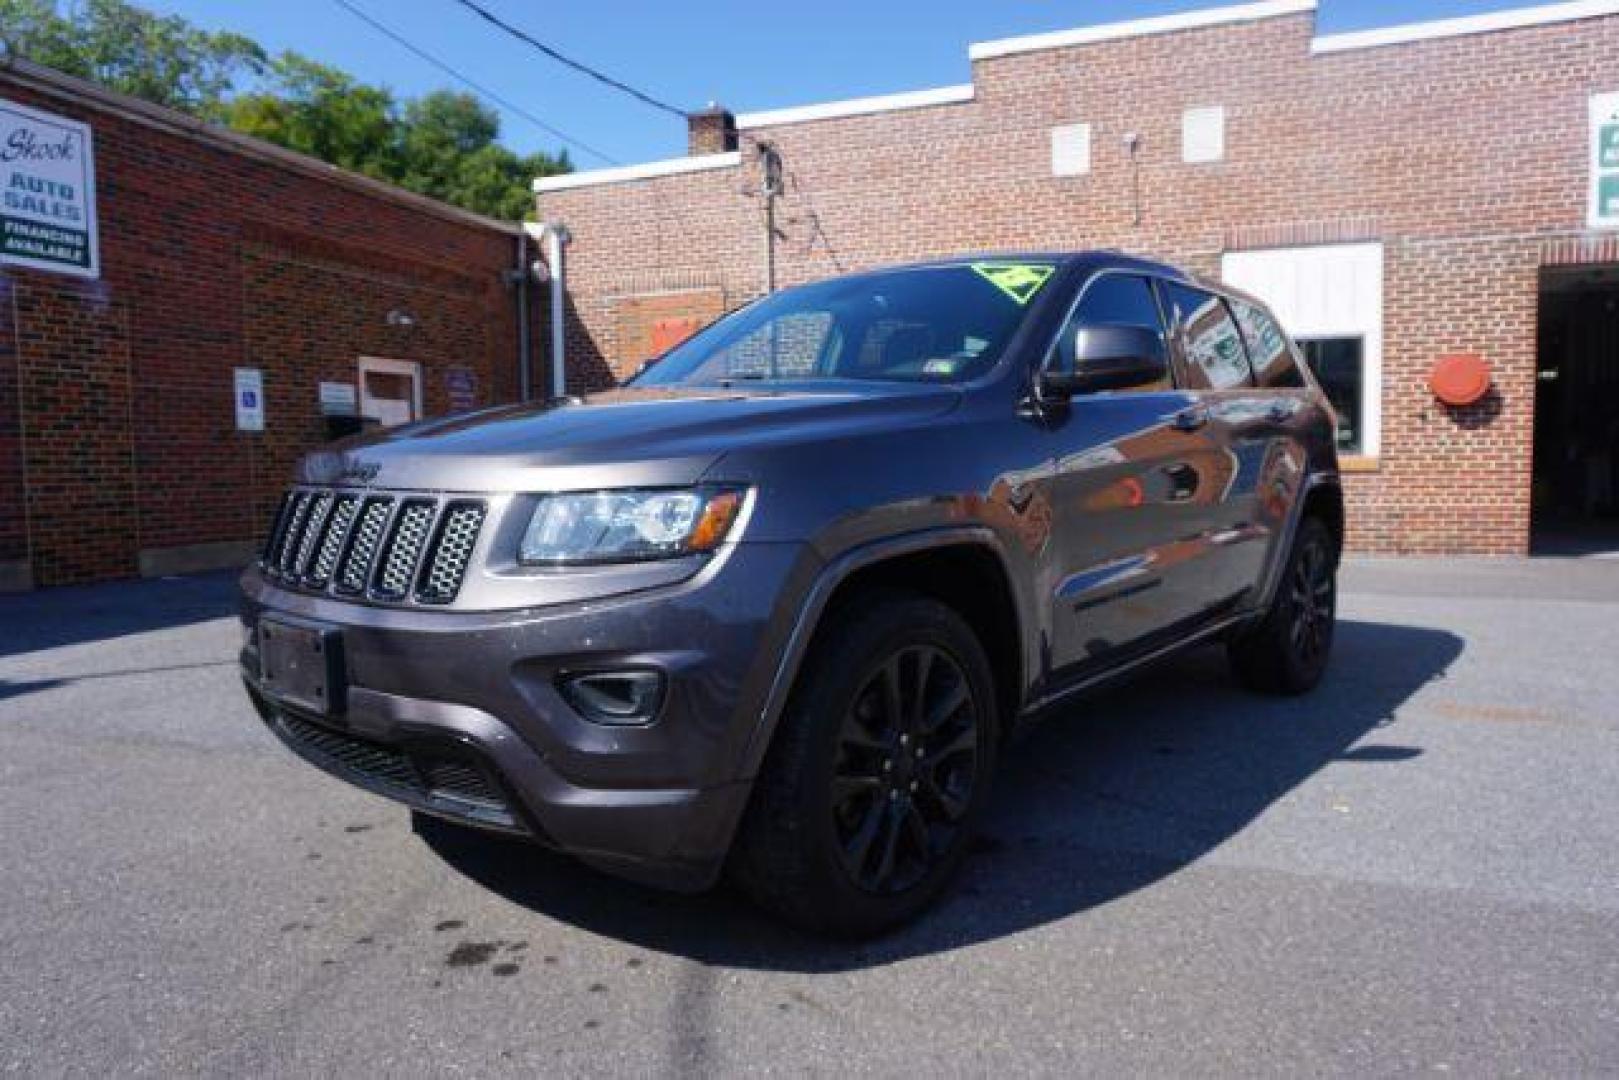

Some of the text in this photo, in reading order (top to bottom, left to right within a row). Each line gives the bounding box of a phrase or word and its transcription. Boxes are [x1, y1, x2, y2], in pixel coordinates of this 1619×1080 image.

[9, 172, 74, 200] AUTO
[4, 191, 81, 220] SALES
[4, 221, 84, 246] FINANCING
[4, 237, 83, 263] AVAILABLE
